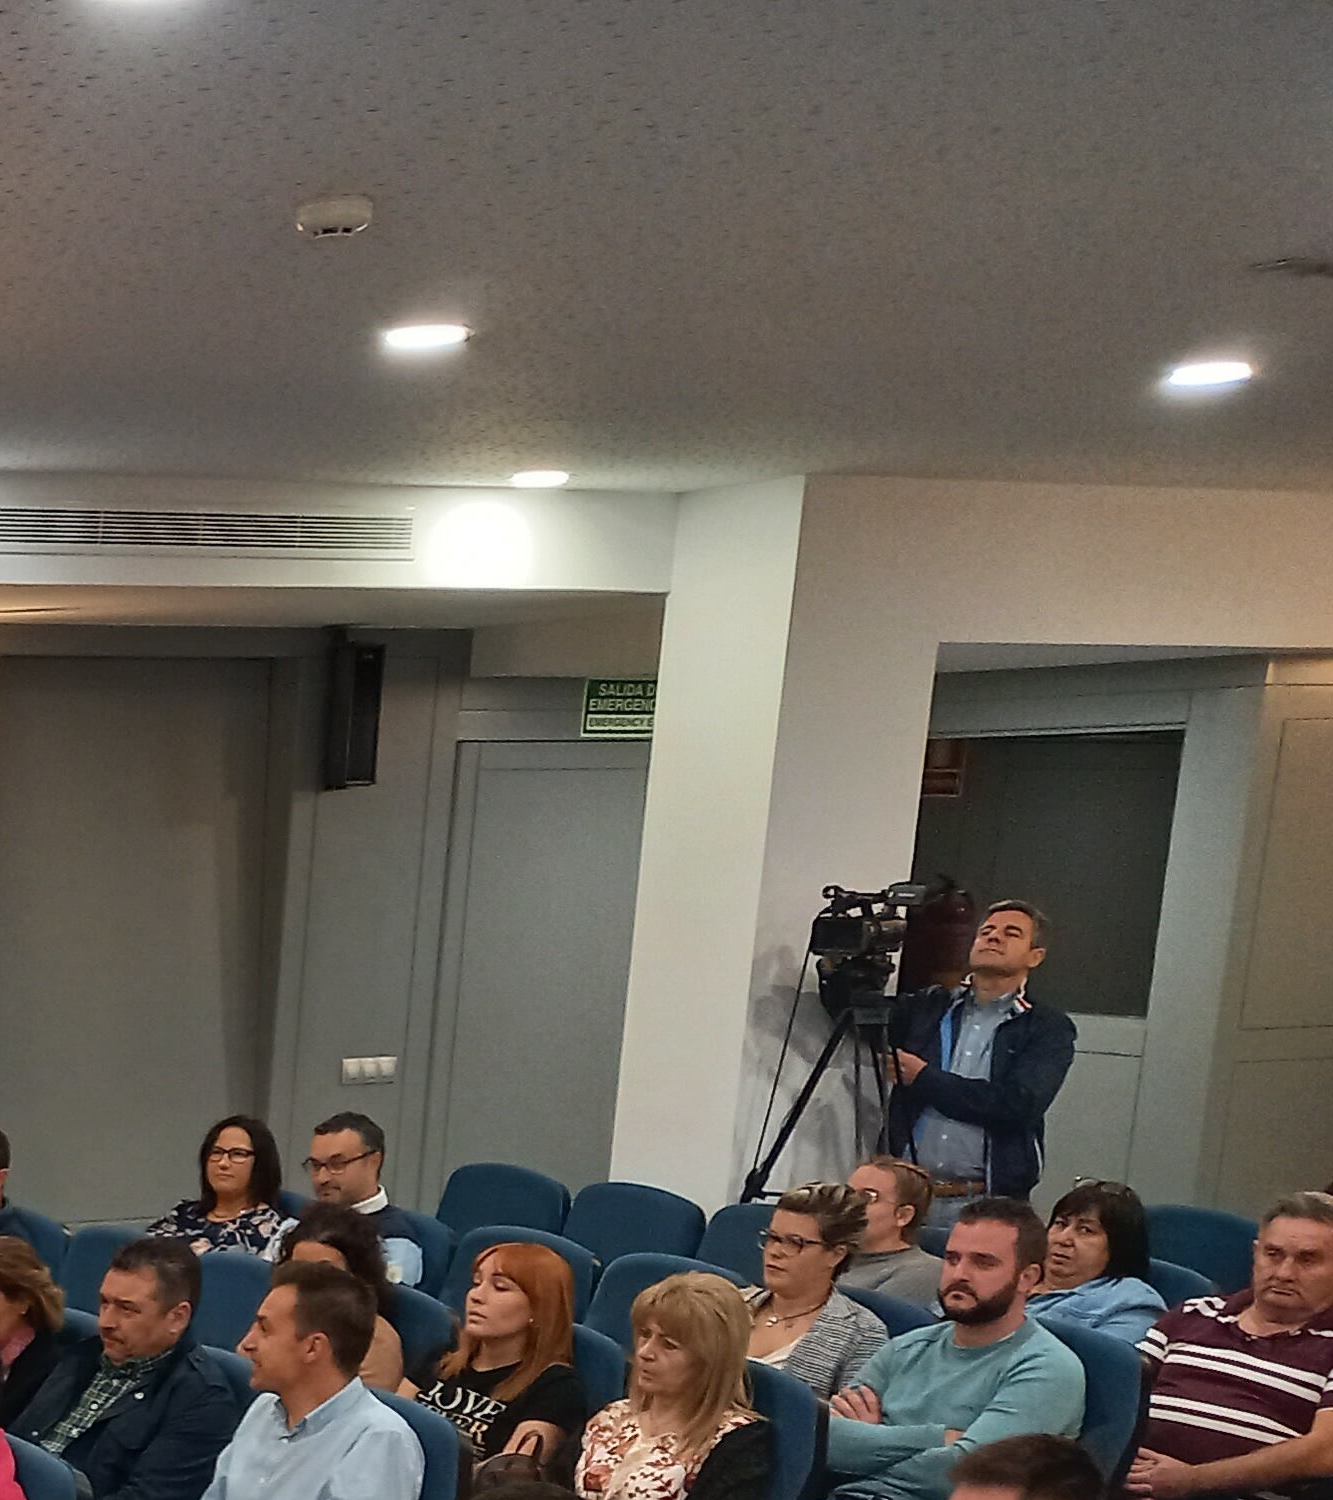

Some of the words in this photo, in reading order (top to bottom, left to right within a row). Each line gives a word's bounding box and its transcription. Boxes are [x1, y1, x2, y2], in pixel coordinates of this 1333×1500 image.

[598, 683, 643, 697] SALIDA
[646, 683, 656, 697] D
[588, 698, 656, 712] EMERGENC
[418, 1380, 507, 1424] LOVE
